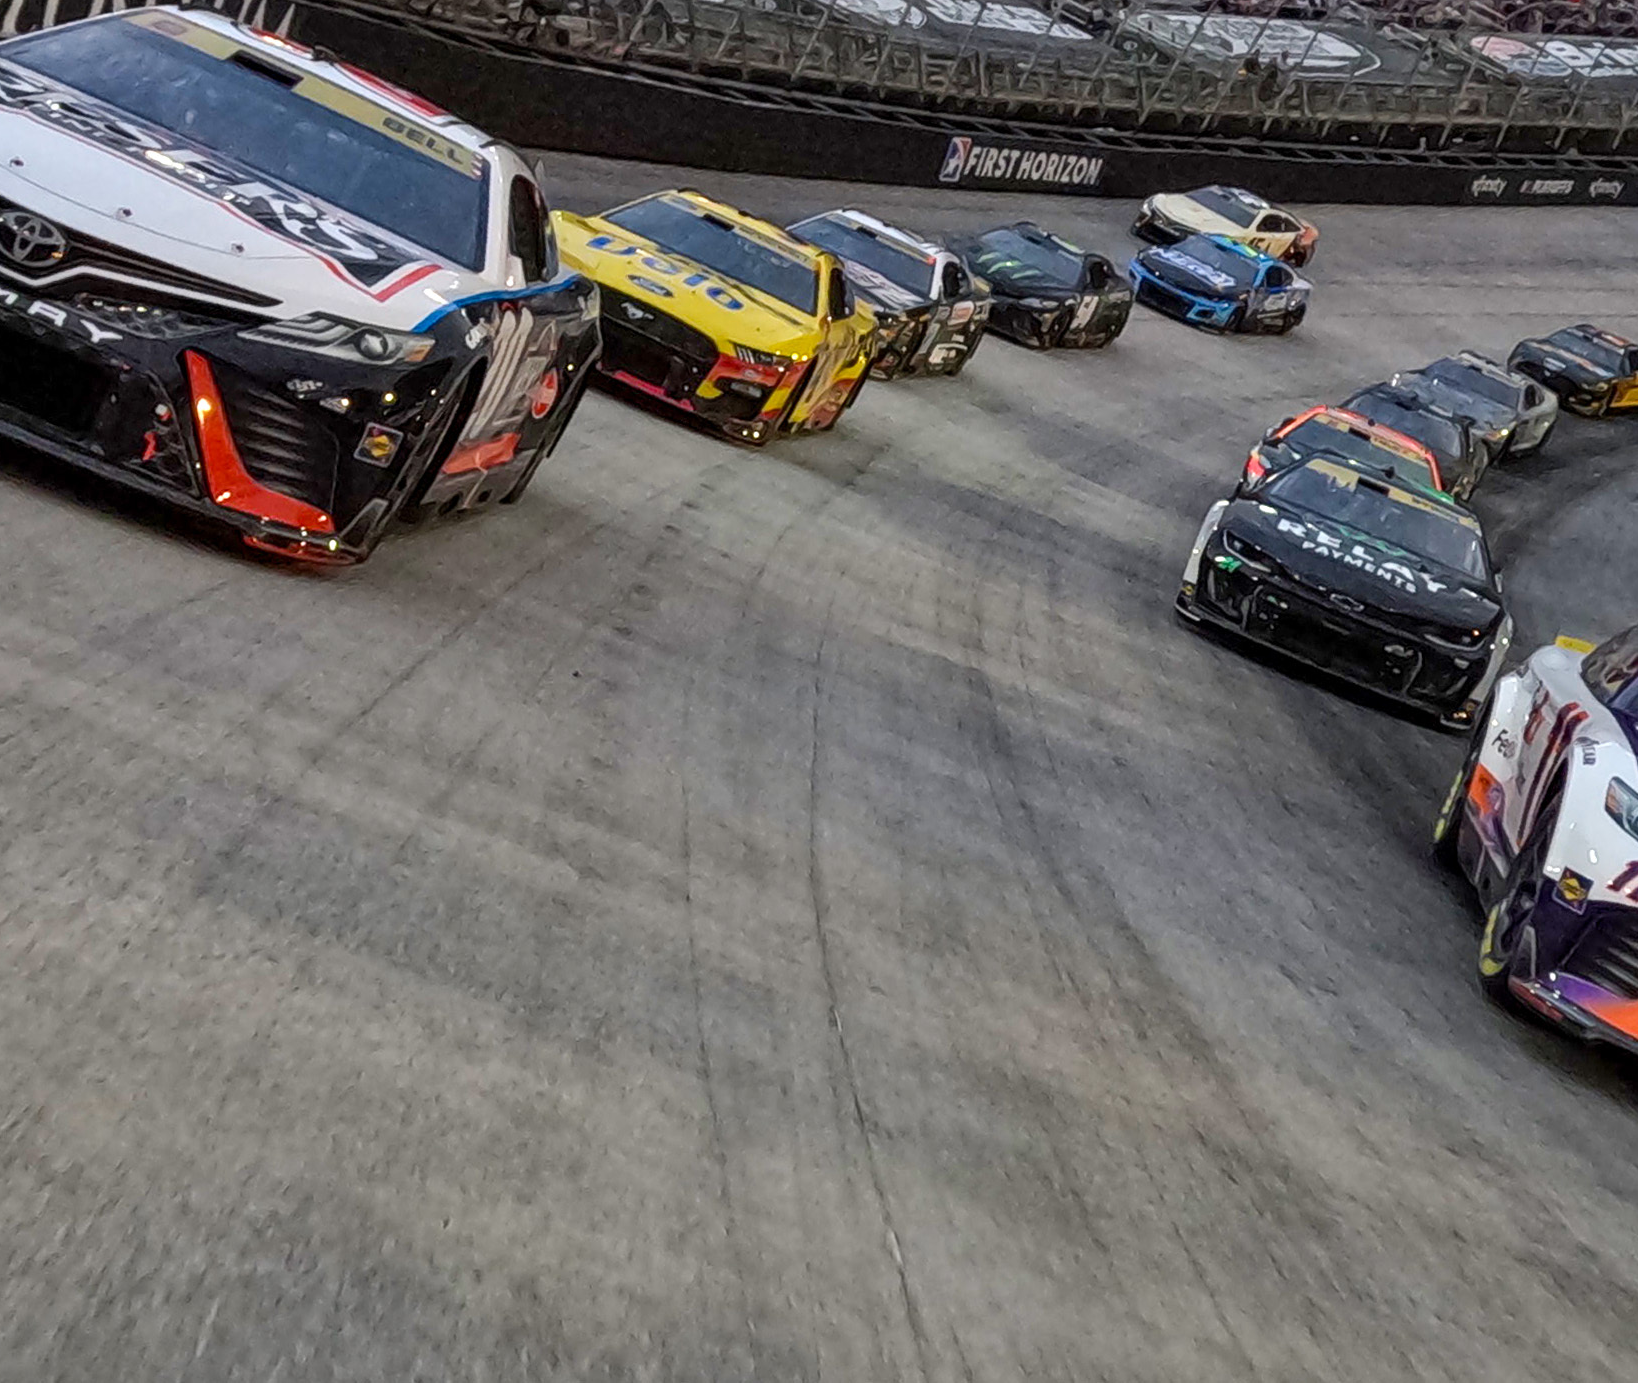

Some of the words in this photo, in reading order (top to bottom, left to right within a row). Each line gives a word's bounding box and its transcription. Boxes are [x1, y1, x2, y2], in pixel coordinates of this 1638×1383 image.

[381, 116, 464, 166] BELL
[964, 146, 1021, 179] FIRST
[1016, 151, 1103, 186] HORIZON
[1277, 518, 1449, 593] RELAY
[1301, 540, 1418, 594] PAYMENTS
